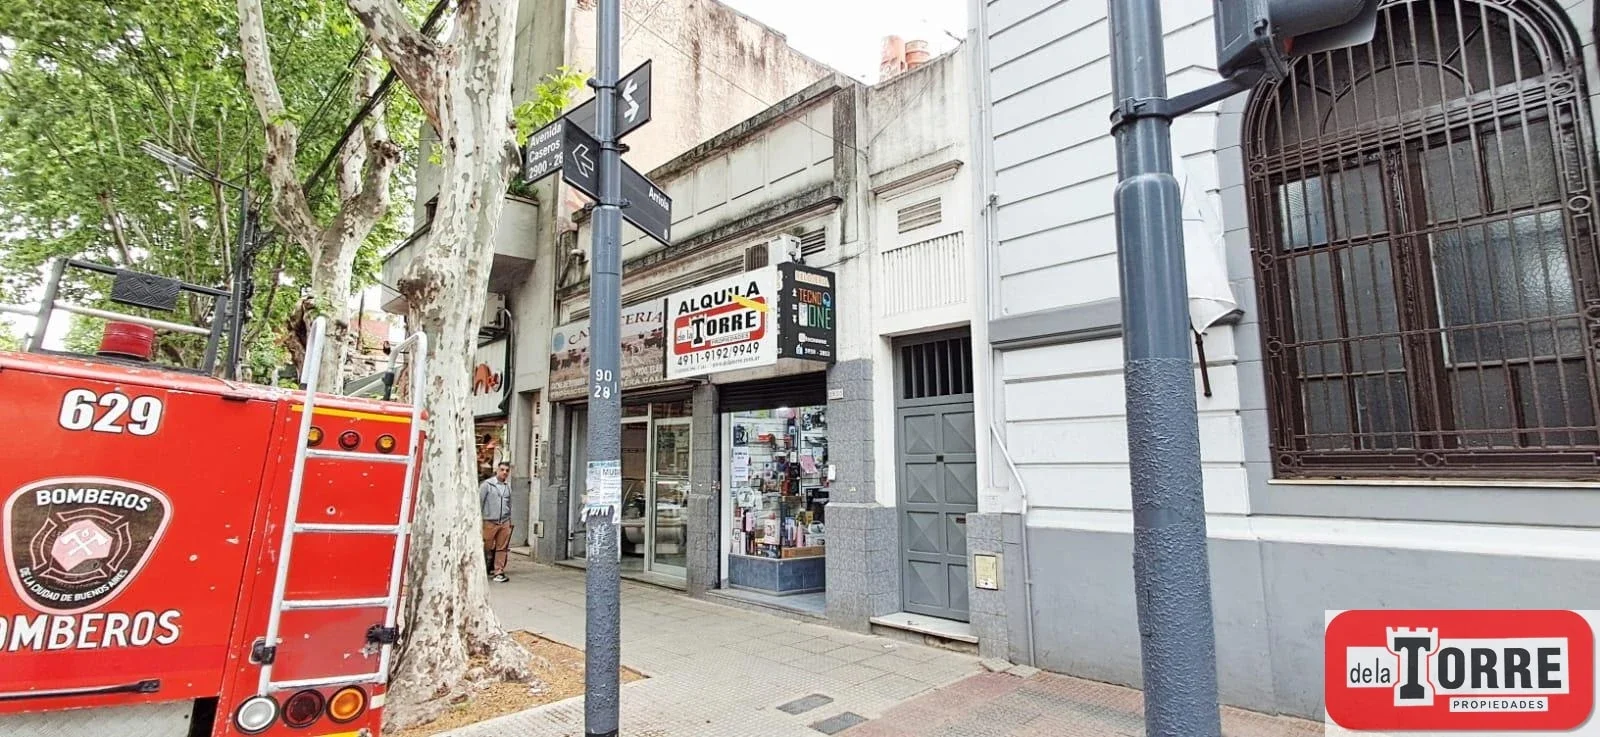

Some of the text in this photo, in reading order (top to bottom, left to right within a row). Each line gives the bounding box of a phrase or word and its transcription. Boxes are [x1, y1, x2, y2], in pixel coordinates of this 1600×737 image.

[530, 122, 562, 147] Avenida
[529, 140, 561, 163] Caseros
[529, 160, 548, 179] 2900
[648, 186, 670, 211] Arriola
[678, 280, 761, 316] ALQUILA
[798, 287, 822, 305] TECNO
[691, 309, 757, 346] TORRE
[595, 368, 613, 382] 90
[593, 384, 612, 400] 28
[58, 387, 163, 436] 629
[36, 488, 152, 512] BOMBEROS
[19, 567, 129, 602] DE LA CIUDAD DE BUENOS AIRES
